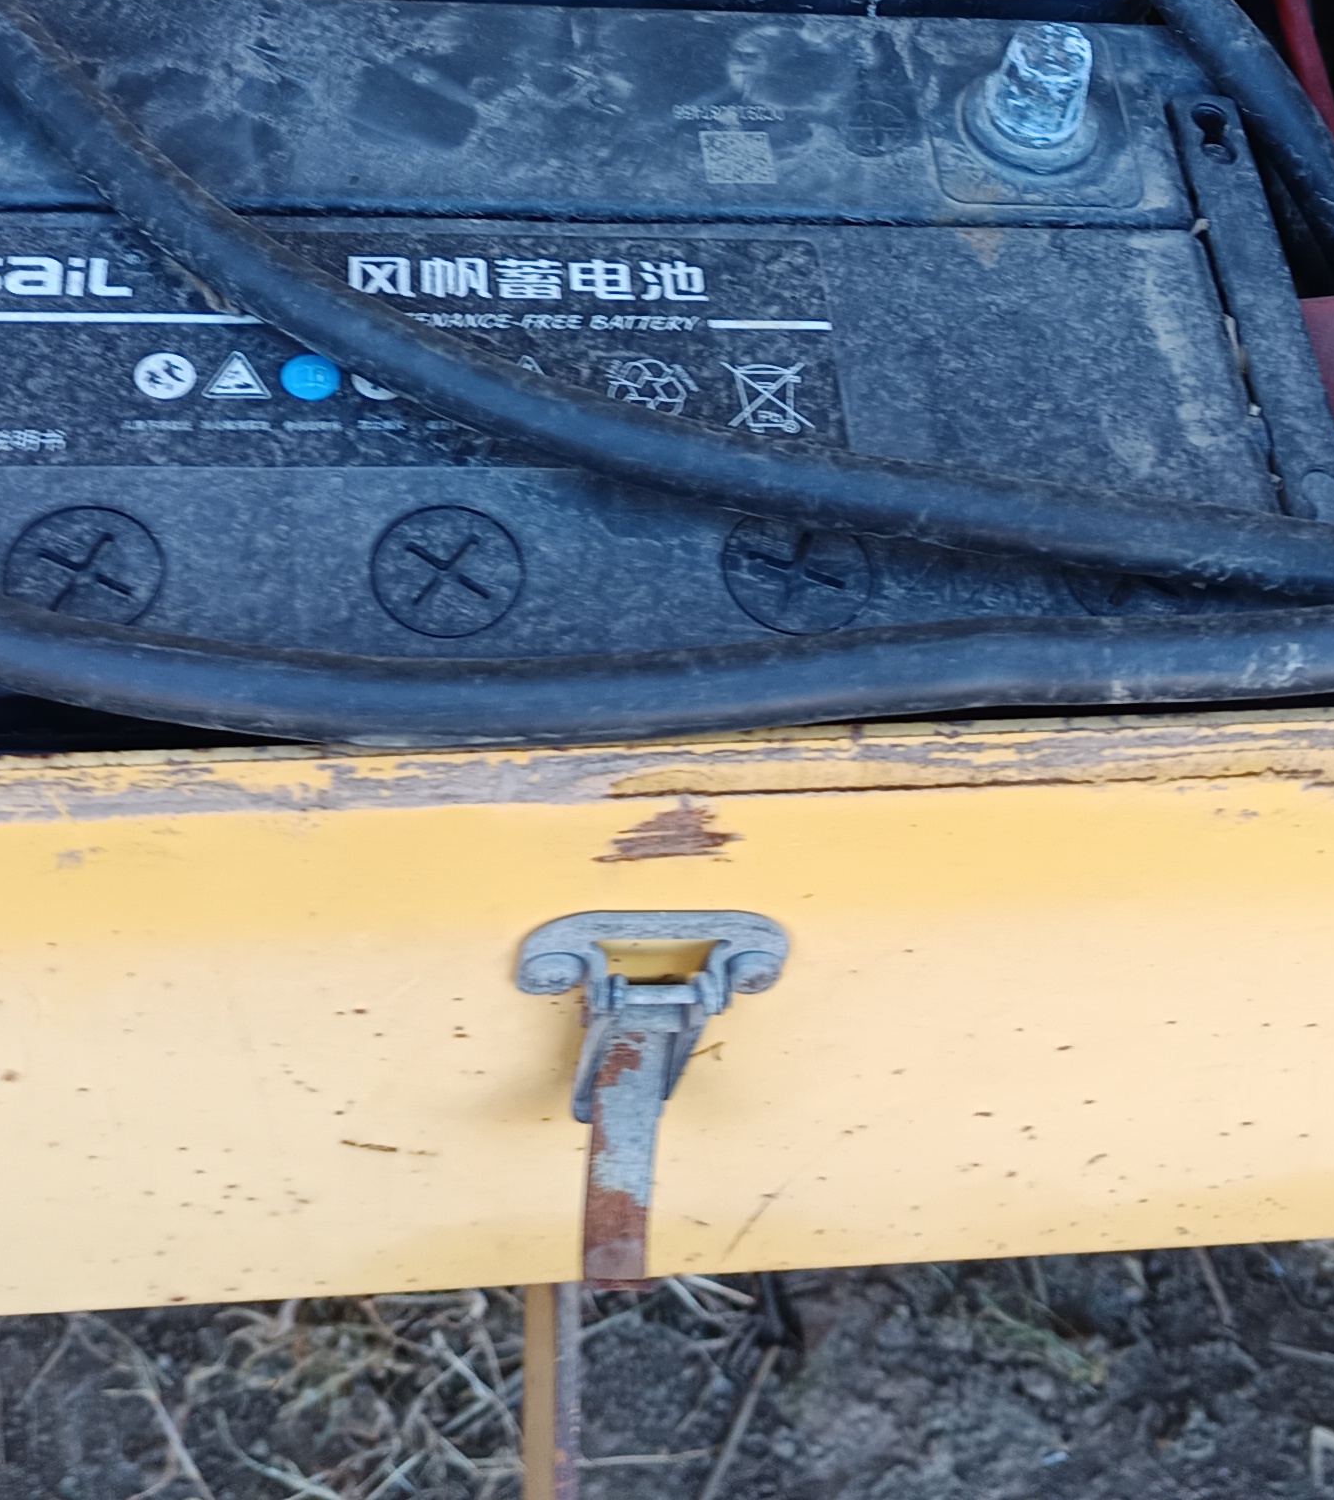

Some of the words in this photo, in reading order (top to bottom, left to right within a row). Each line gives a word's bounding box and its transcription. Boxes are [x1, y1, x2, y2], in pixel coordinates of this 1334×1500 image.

[347, 255, 710, 302] 风帆蓄电池
[589, 314, 701, 332] BATTERY
